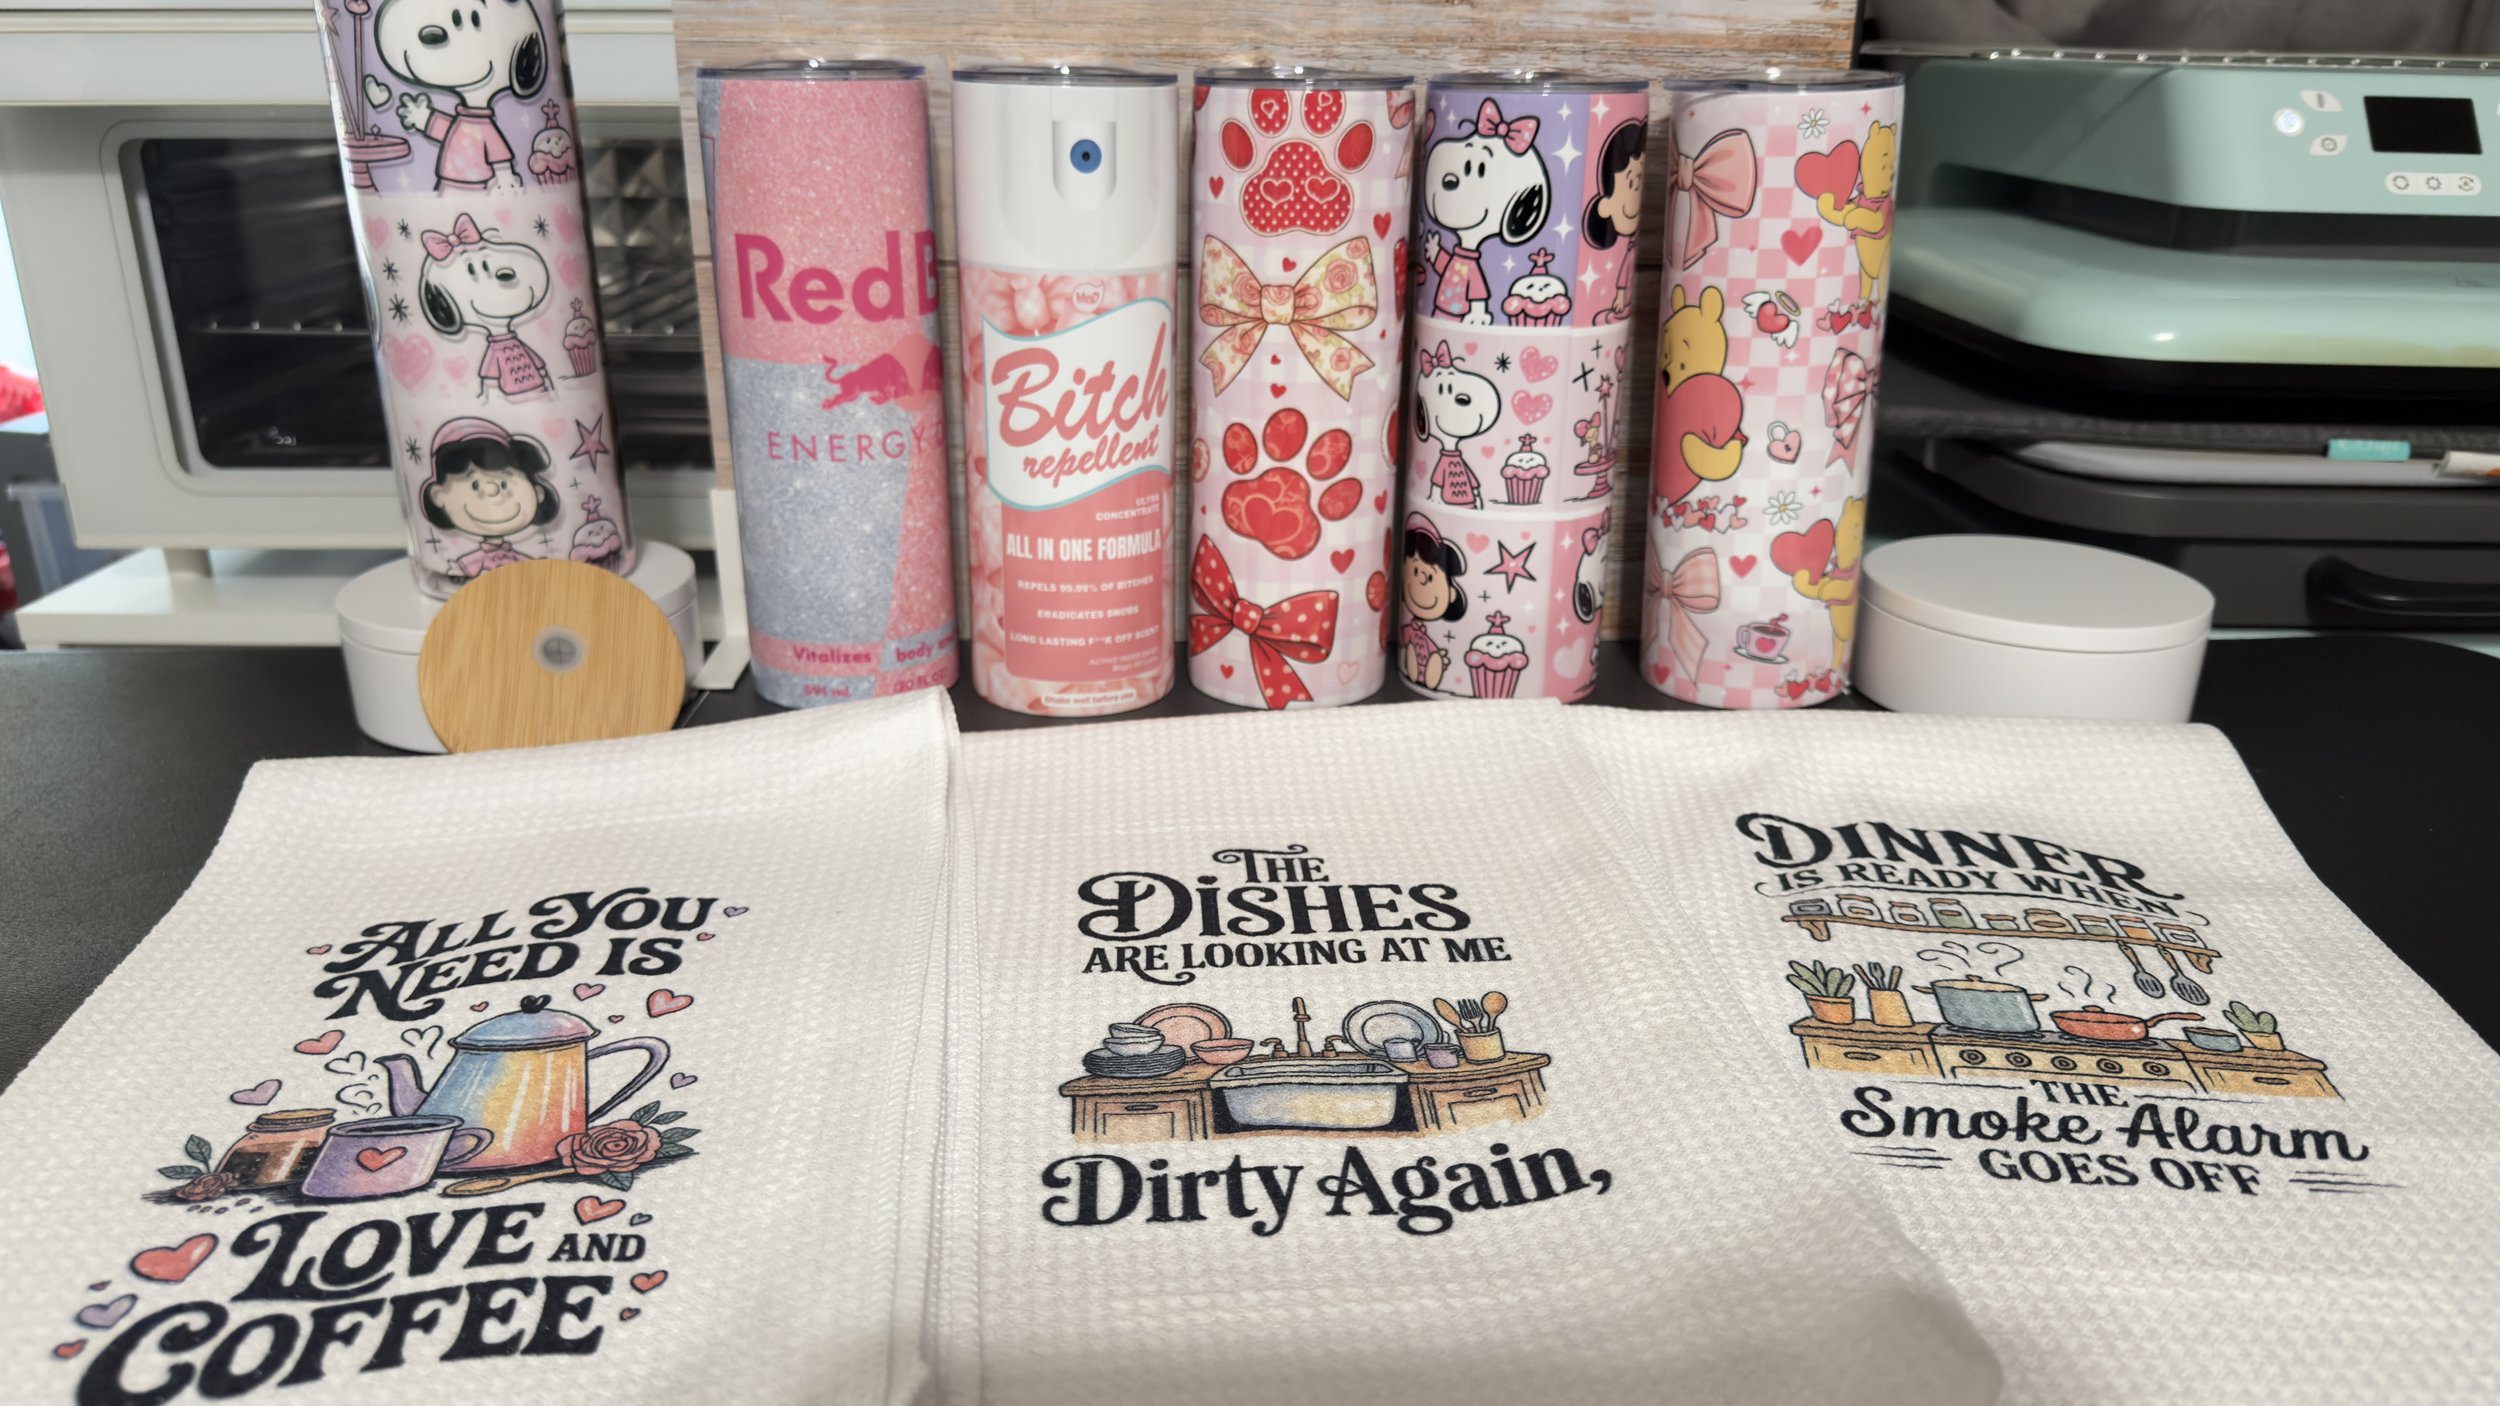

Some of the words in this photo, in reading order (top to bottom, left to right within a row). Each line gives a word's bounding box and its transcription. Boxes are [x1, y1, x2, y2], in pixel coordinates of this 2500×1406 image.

[991, 321, 1168, 448] Bitch
[767, 422, 926, 463] ENERGY
[1023, 424, 1159, 489] repellent
[1095, 504, 1160, 521] CONCENTRATE
[1006, 533, 1033, 559] ALL
[1037, 538, 1054, 561] IN
[1059, 538, 1093, 562] ONE
[1097, 528, 1162, 561] FORMULA
[1017, 580, 1057, 593] REPELS
[1100, 581, 1115, 592] OF
[1117, 575, 1154, 590] BITCHES
[1010, 632, 1037, 645] LONG
[1039, 636, 1086, 647] LASTING
[1115, 632, 1133, 643] OFF
[1037, 609, 1104, 620] ERADICATES
[792, 646, 872, 664] Vitalizes
[896, 642, 933, 662] body
[1212, 844, 1330, 883] THE
[1736, 812, 2186, 900] DINNER
[1773, 868, 1824, 892] IS
[1836, 863, 2000, 892] READY
[2014, 872, 2181, 918] WHEN
[324, 910, 516, 973] ALL
[529, 887, 719, 940] YOU
[313, 941, 580, 1022] NEED
[595, 937, 684, 977] IS
[1082, 944, 1196, 986] ARE
[1182, 939, 1367, 971] LOOKING
[1380, 937, 1431, 963] AT
[1447, 936, 1512, 963] ME
[2029, 1079, 2131, 1108] THE
[1840, 1085, 2102, 1139] Smoke
[2115, 1102, 2371, 1163] Alarm
[1041, 1153, 1304, 1237] Dirty
[1317, 1142, 1612, 1236] Again,
[1976, 1148, 2140, 1187] GOES
[2150, 1157, 2263, 1197] OFF
[229, 1202, 546, 1301] LOVE
[548, 1233, 646, 1262] AND
[76, 1275, 614, 1406] COFFEE
